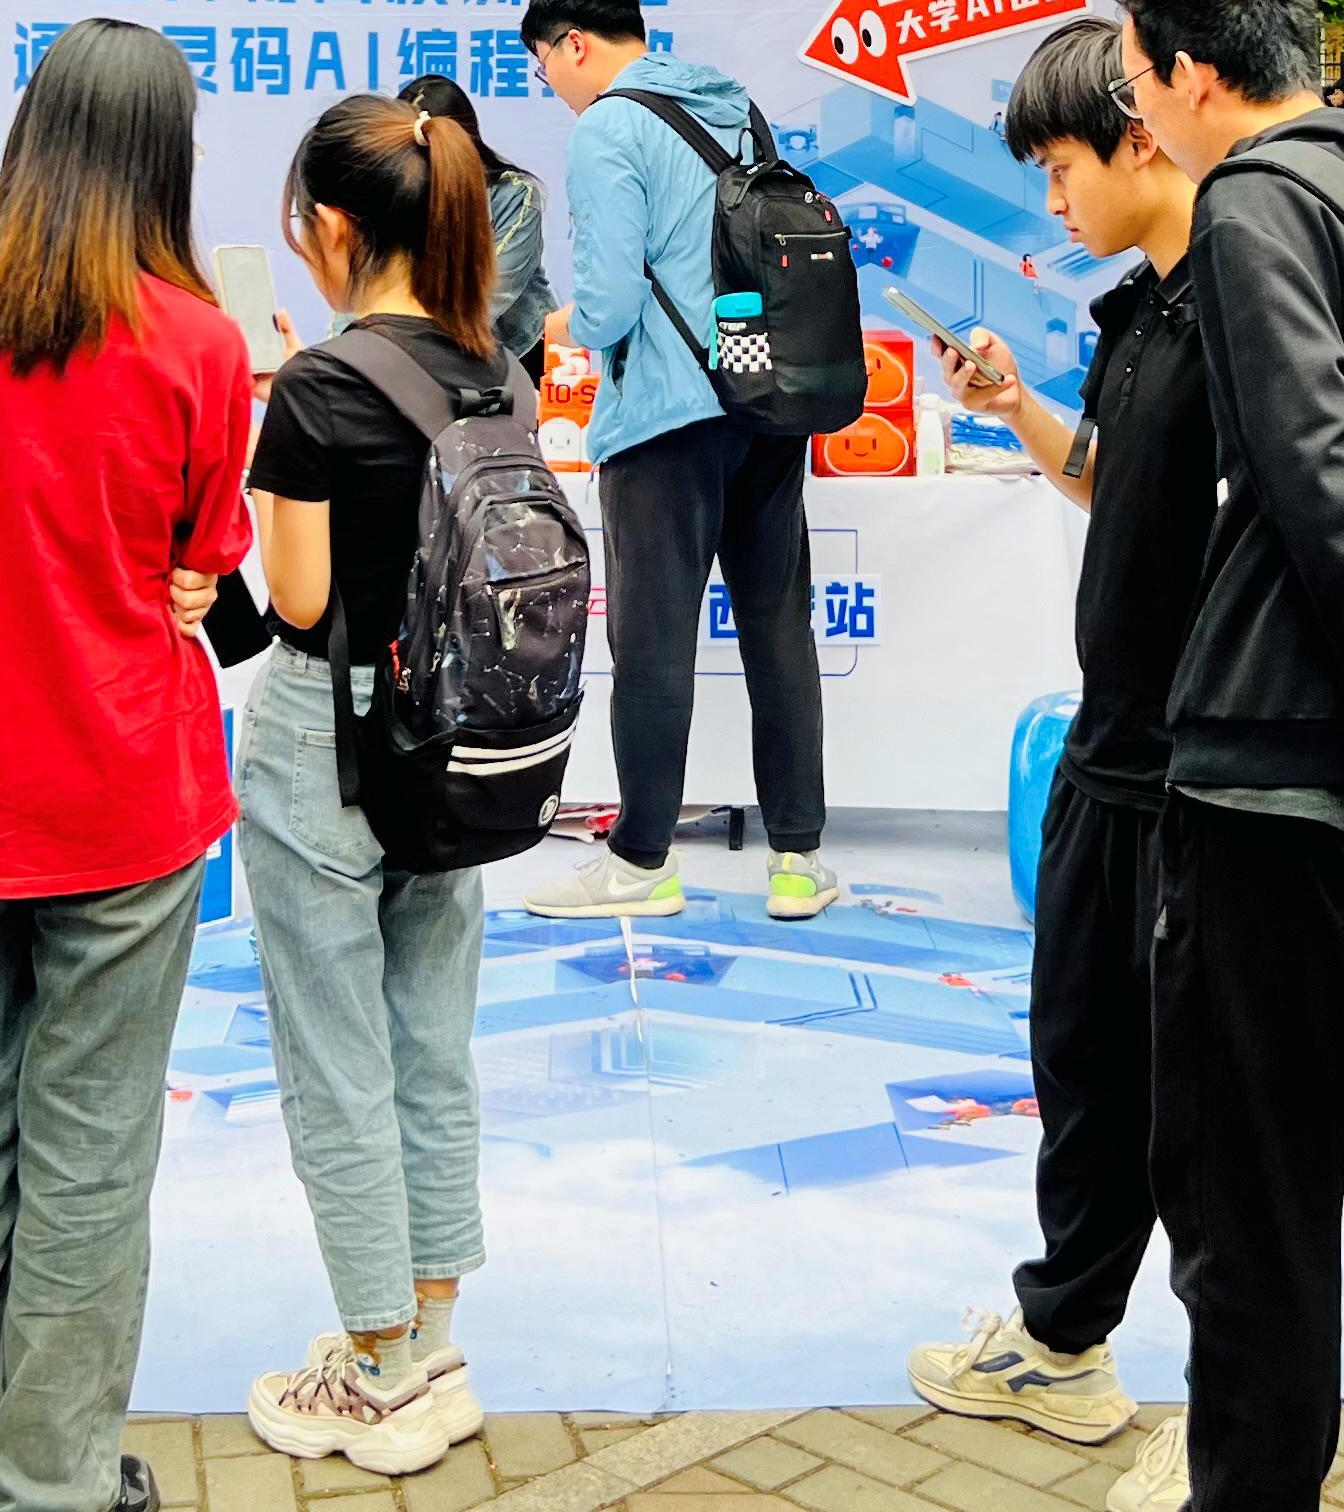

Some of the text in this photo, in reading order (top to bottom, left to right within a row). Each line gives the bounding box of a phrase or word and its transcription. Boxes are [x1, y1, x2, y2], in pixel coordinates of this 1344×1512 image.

[14, 22, 673, 98] 通灵码AI编程
[709, 581, 876, 639] 西站
